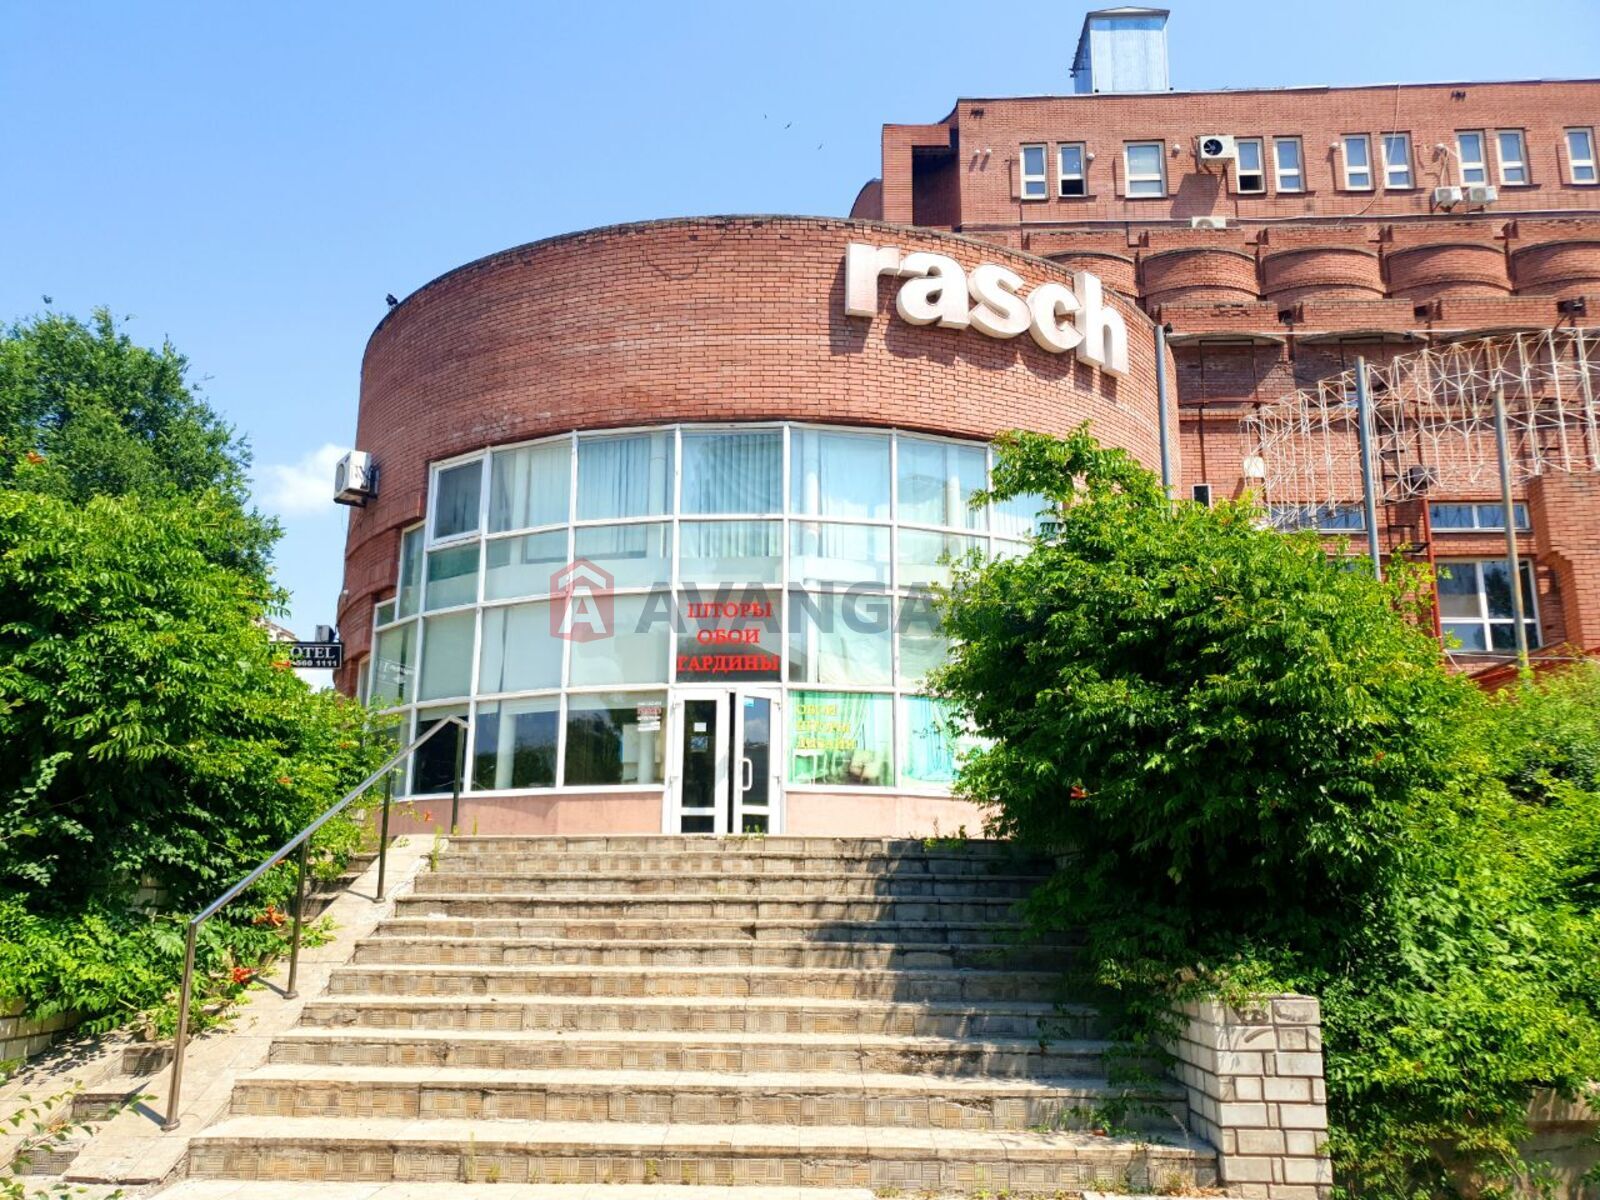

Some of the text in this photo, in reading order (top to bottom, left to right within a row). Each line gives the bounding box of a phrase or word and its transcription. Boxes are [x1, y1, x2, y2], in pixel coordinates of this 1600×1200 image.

[845, 242, 1130, 378] rasch
[687, 601, 773, 619] ШТОРЫ
[697, 628, 761, 645] ОБОИ
[289, 646, 335, 659] OTEL
[676, 653, 781, 675] ГАРДИНЫ
